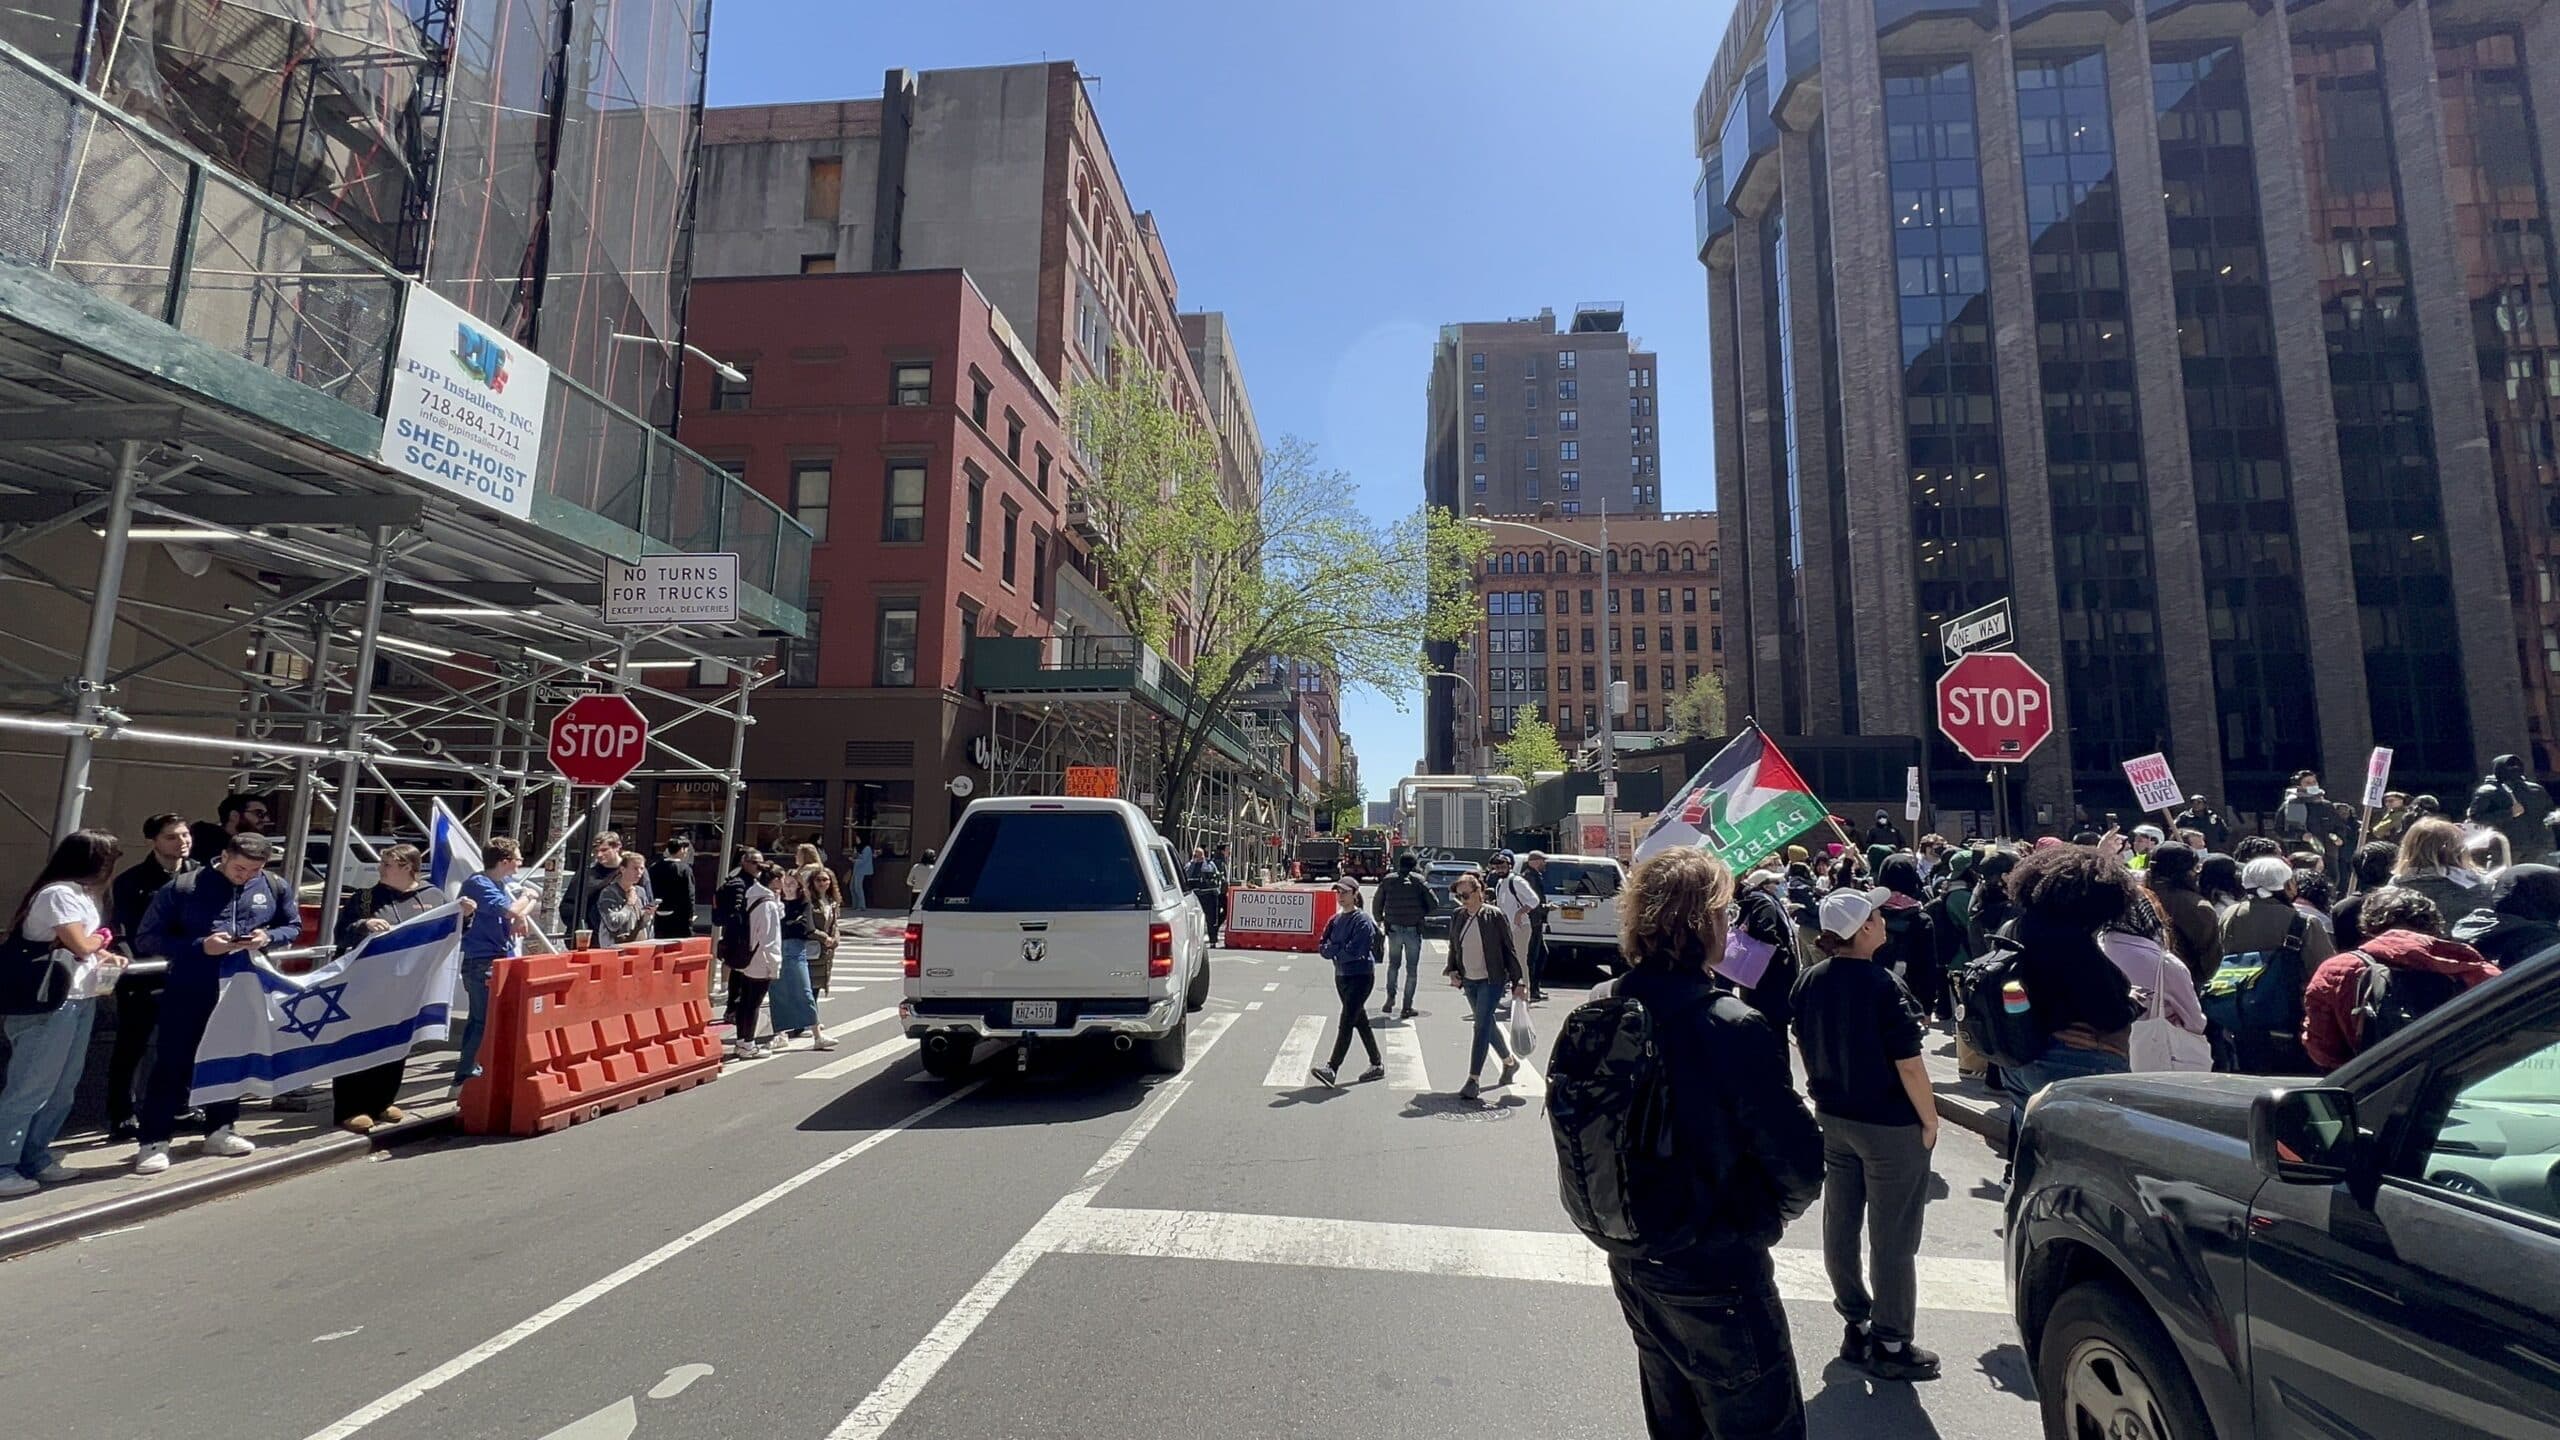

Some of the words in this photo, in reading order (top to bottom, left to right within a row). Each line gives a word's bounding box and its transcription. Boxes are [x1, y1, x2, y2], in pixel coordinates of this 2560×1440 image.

[407, 359, 440, 384] PJP
[442, 377, 507, 422] Installers,
[509, 412, 534, 435] INC.
[420, 388, 521, 450] 718.484.1711
[419, 408, 516, 460] info@pjpinstallers.com
[405, 445, 515, 503] SCAFFOLD
[624, 568, 646, 581] NO
[658, 567, 717, 580] TURNS
[613, 588, 646, 600] FOR
[658, 586, 728, 600] TRUCKS
[611, 606, 643, 615] EXCEPT
[648, 606, 677, 614] LOCAL
[680, 605, 729, 613] DELIVERIES
[1952, 628, 1971, 648] ONE
[1979, 616, 2001, 638] WAY
[1948, 687, 2040, 726] STOP
[556, 723, 639, 758] STOP
[2131, 765, 2167, 785] NOW
[2136, 784, 2151, 794] LET
[2152, 778, 2175, 790] GAZA
[1241, 894, 1265, 904] ROAD
[1268, 895, 1304, 905] CLOSED
[1267, 907, 1277, 916] TO
[1239, 917, 1264, 927] THRU
[1266, 917, 1303, 928] TRAFFIC
